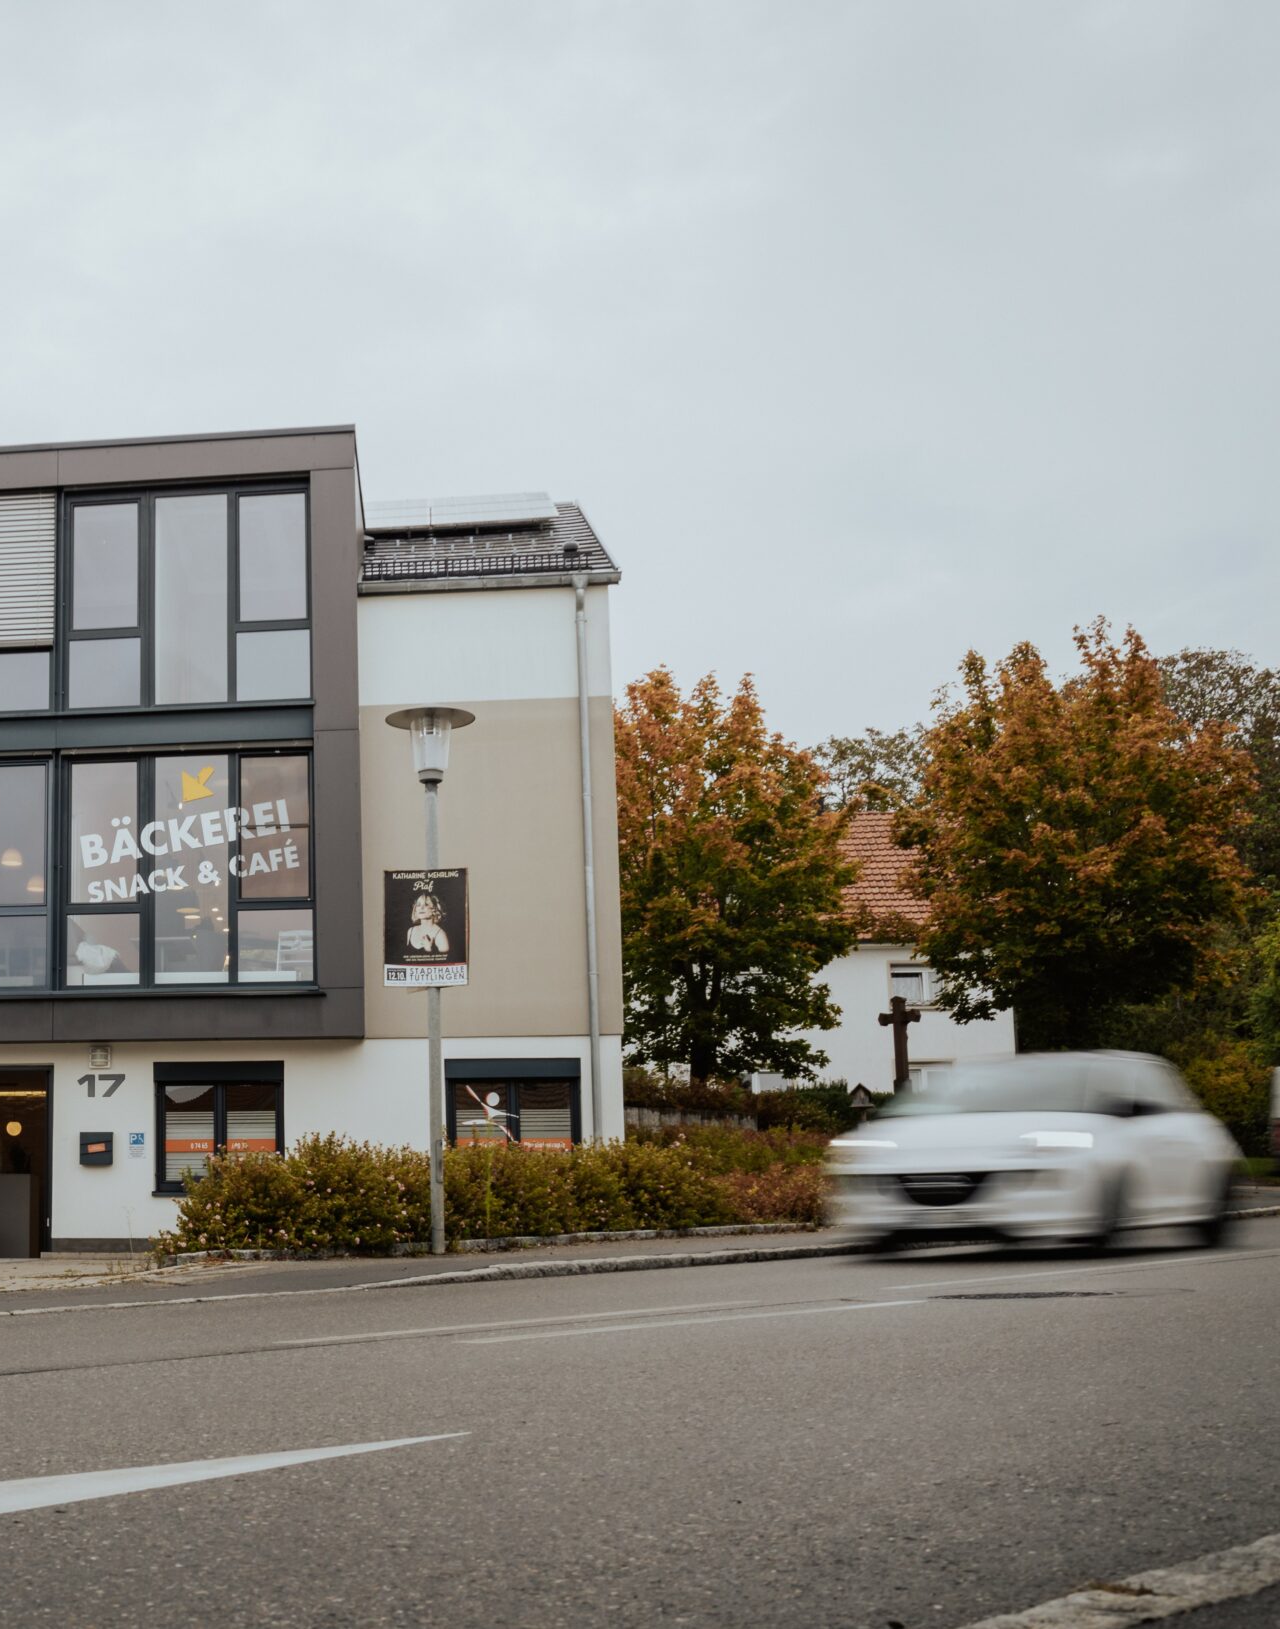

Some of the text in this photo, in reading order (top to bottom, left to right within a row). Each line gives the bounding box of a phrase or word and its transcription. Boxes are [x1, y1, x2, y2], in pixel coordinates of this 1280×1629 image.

[80, 799, 291, 868] BÄCKEREI
[87, 839, 300, 904] SNACK & CAFÉ
[413, 880, 434, 892] Piaf
[409, 966, 465, 975] STADTHALLE
[409, 973, 465, 981] TUTTLINGEN
[77, 1074, 126, 1097] 17
